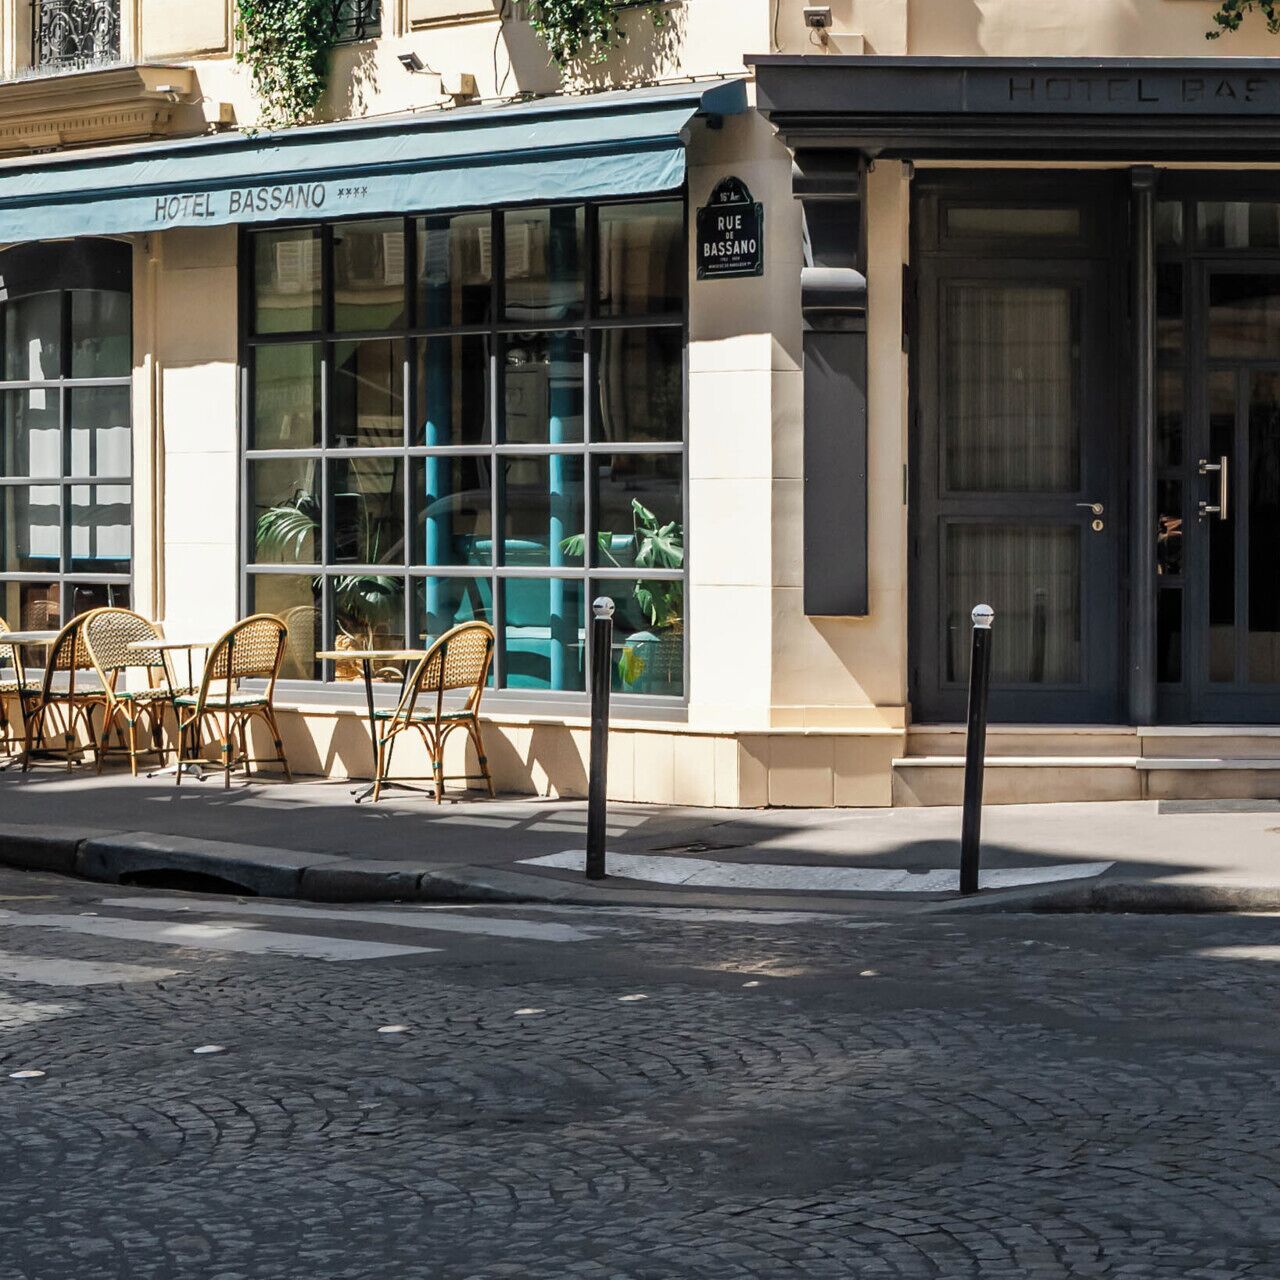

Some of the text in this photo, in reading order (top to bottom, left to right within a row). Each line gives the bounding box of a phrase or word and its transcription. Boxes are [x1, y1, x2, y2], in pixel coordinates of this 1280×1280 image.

[1008, 77, 1159, 103] HOTEL
[154, 183, 326, 222] HOTEL BASSANO
[717, 215, 742, 231] RUE
[725, 231, 734, 240] DE
[703, 239, 757, 257] BASSANO
